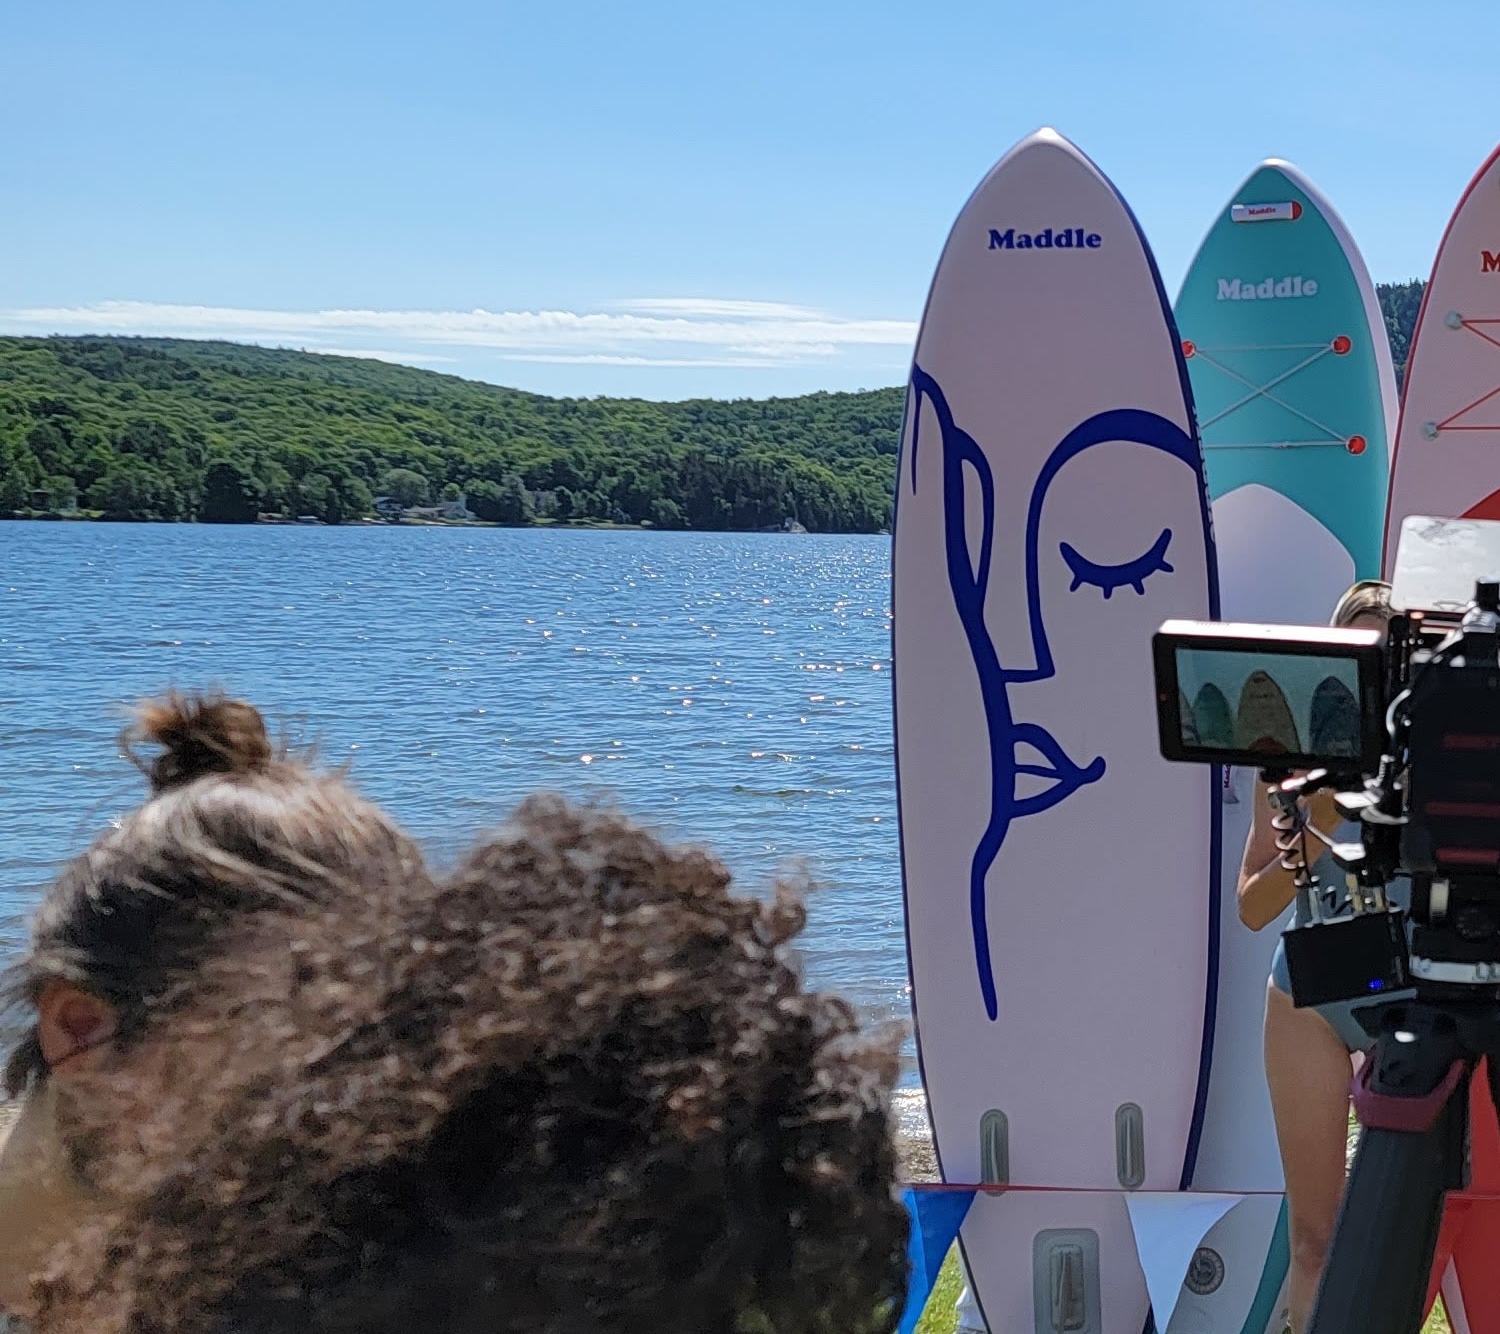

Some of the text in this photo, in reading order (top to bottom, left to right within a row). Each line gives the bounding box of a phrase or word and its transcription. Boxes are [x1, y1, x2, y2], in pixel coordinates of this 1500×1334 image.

[1248, 206, 1277, 216] Maddle
[988, 228, 1102, 250] Maddle
[1216, 276, 1318, 300] Maddle
